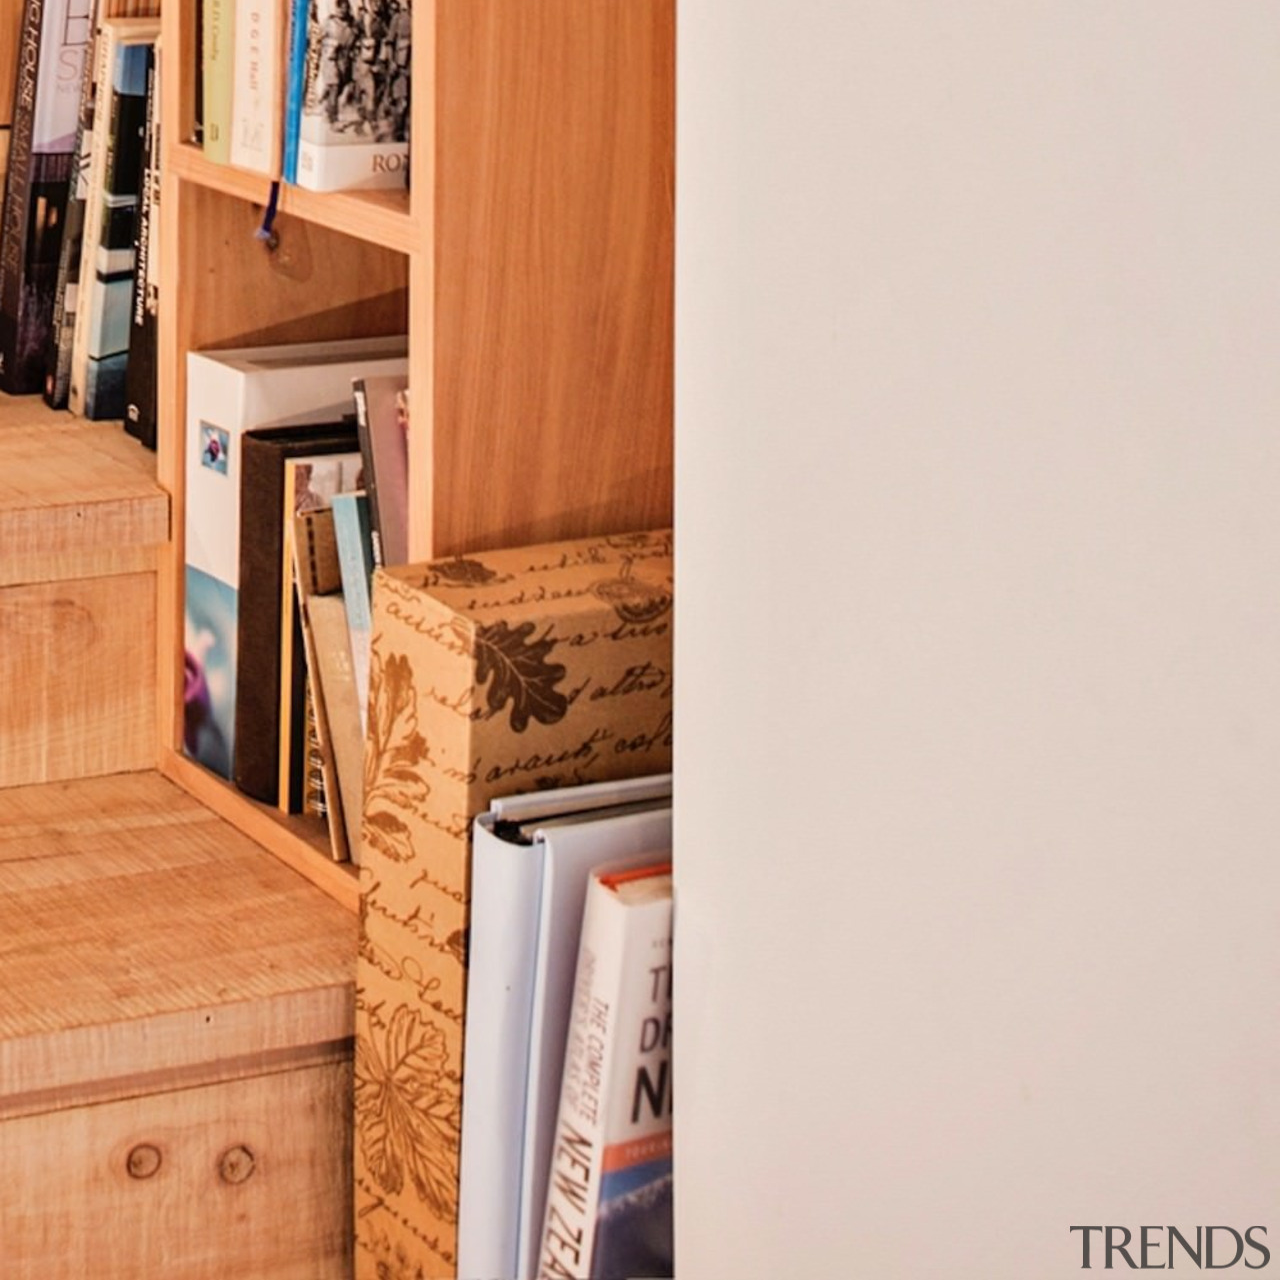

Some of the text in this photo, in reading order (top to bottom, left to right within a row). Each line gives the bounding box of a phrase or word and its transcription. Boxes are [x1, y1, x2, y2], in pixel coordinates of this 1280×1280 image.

[22, 27, 38, 112] HOUSE
[140, 167, 152, 213] LOCAL
[134, 215, 150, 326] ARCHITECTURE
[586, 1033, 606, 1127] COMPLETE
[554, 1118, 594, 1214] NEW
